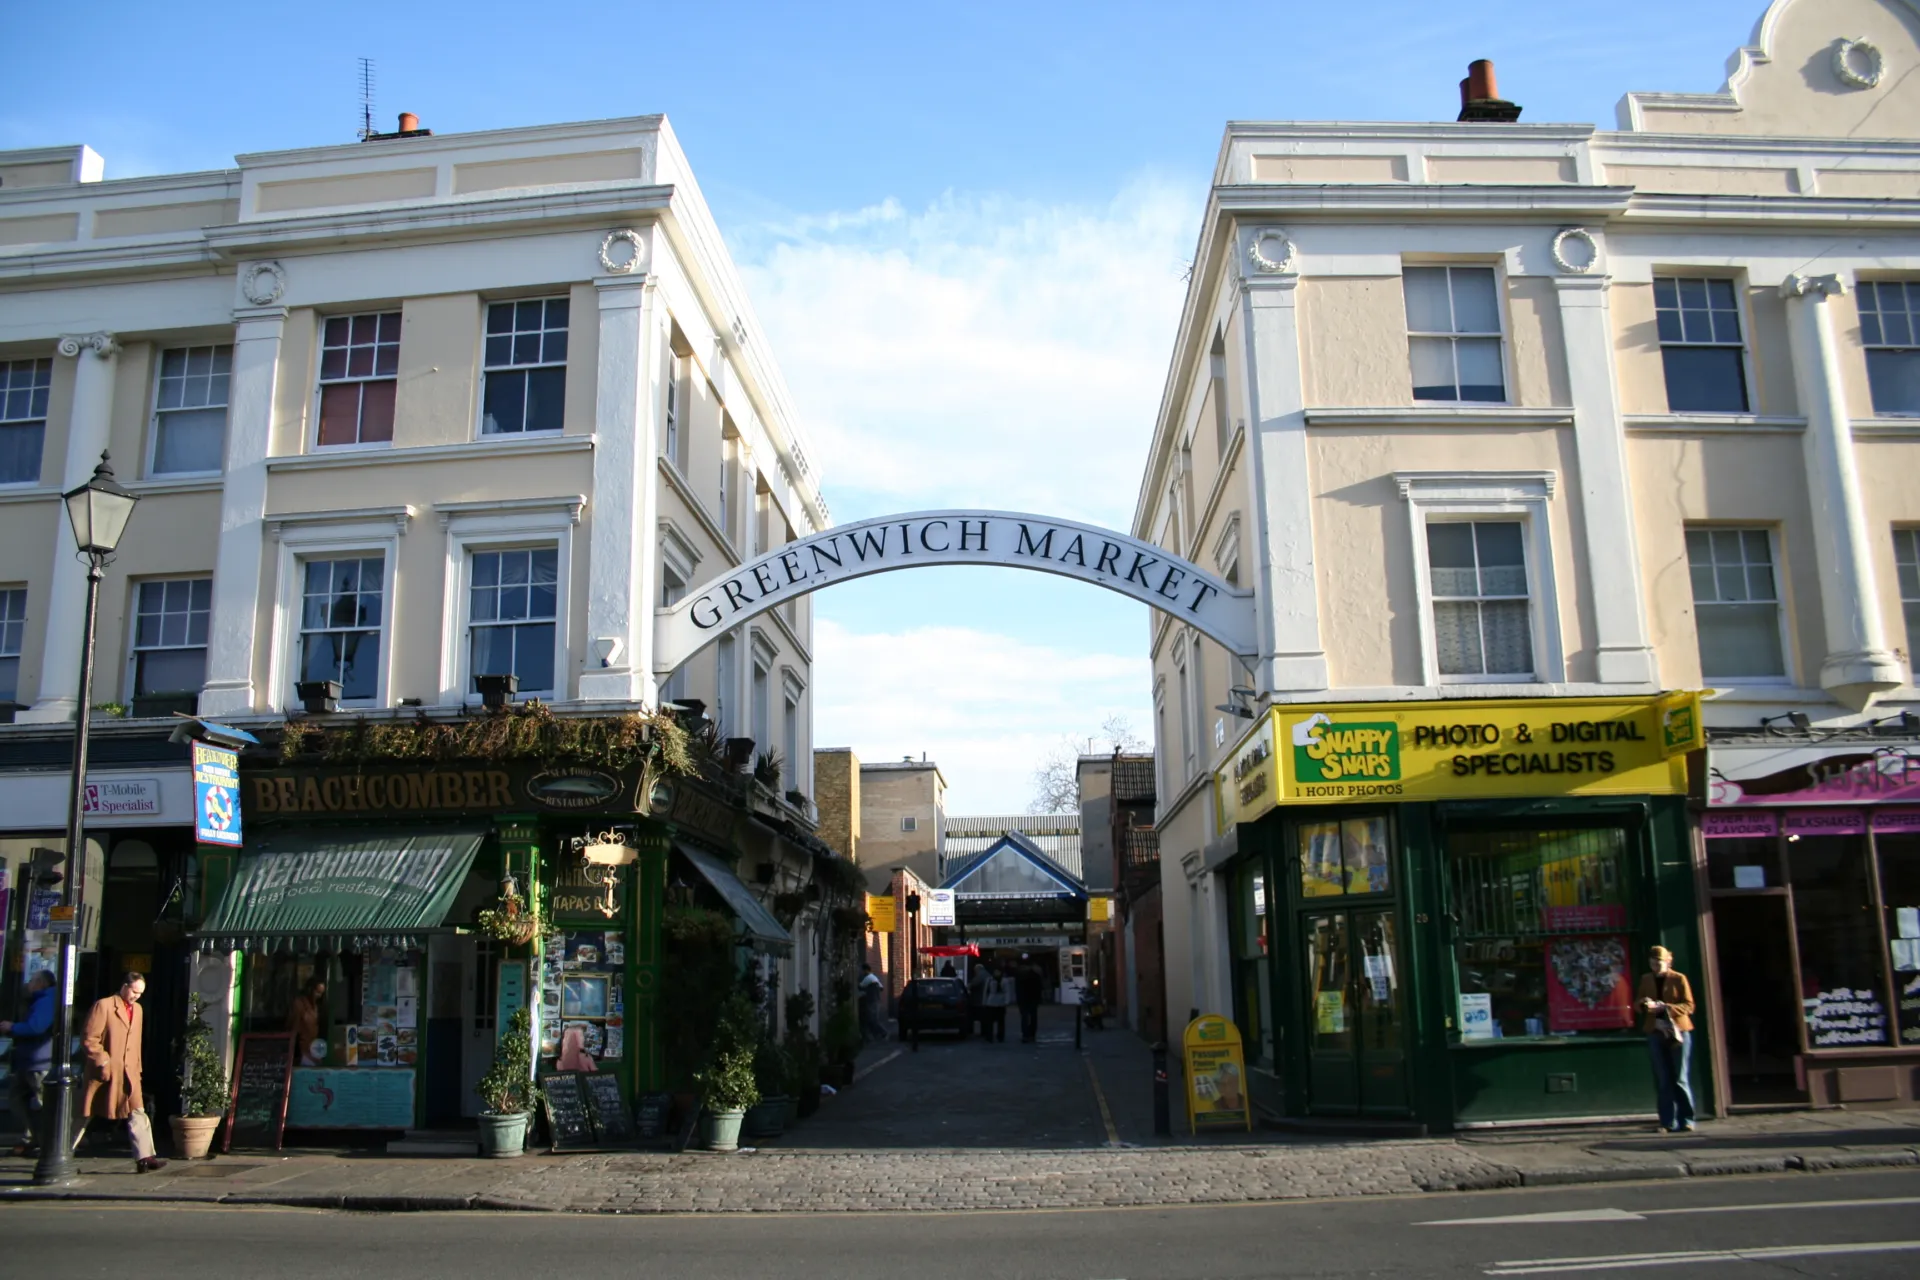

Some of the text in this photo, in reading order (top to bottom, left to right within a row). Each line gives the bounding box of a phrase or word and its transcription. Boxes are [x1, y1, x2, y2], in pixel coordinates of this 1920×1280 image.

[690, 520, 1218, 630] GREENWICH MARKET
[1306, 726, 1392, 760] SNAPPY
[1415, 721, 1645, 746] PHOTO & DIGITAL
[1320, 753, 1391, 780] SNAPS
[1452, 751, 1615, 776] SPECIALISTS
[101, 784, 147, 796] T-Mobile
[252, 771, 516, 812] BEACHCOMBER
[1296, 785, 1403, 797] 1 HOUR PHOTOS
[102, 801, 155, 814] Specialist
[545, 796, 602, 808] RESTAURANT
[1706, 824, 1773, 834] FLAVOURS
[1709, 815, 1744, 824] OVER
[1785, 814, 1862, 828] MILKSHAKES
[240, 848, 452, 896] BEACHCOMBER
[248, 881, 421, 908] seafood restaurant
[554, 895, 592, 912] TAPAS
